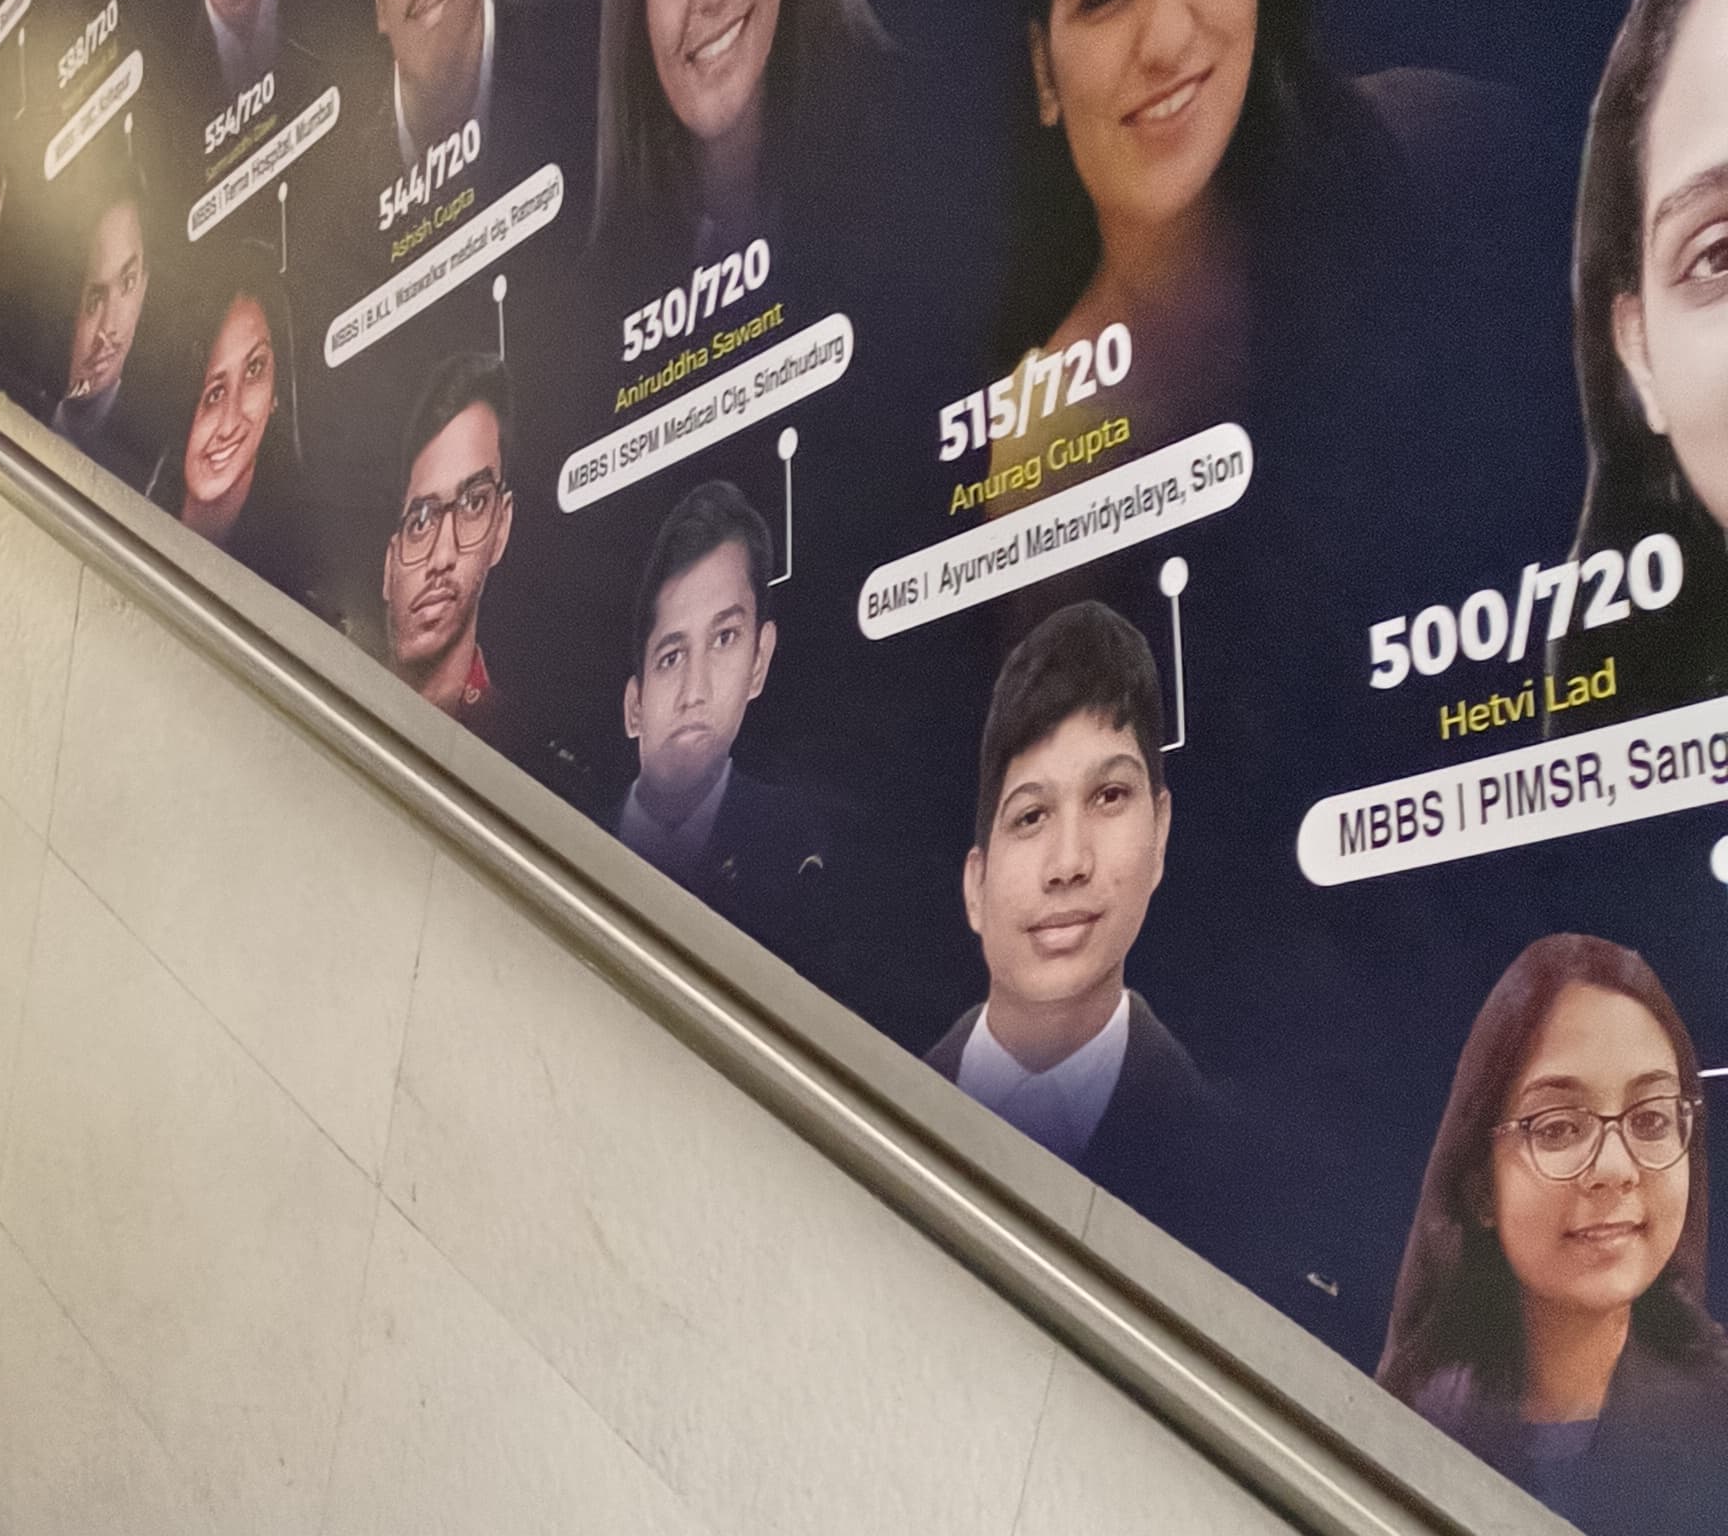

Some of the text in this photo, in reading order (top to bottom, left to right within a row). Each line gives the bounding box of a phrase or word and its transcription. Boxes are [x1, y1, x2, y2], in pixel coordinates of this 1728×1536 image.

[204, 70, 275, 155] 554/720
[377, 119, 481, 232] 544/720
[390, 187, 475, 263] Ashish Gupta
[623, 238, 770, 362] 530/720
[614, 302, 786, 414] Aniruddha Sawant
[938, 322, 1133, 463] 515/720
[567, 457, 609, 495] MBBS
[618, 431, 660, 469] SSPM
[662, 395, 719, 446] Medical
[753, 334, 846, 399] Sindhudurg
[948, 417, 1131, 516] Anurag Gupta
[867, 578, 920, 621] BAMS
[937, 534, 1020, 596] Ayurved
[1025, 475, 1188, 559] Mahavidyalaya,
[1189, 449, 1245, 493] Sion
[1368, 531, 1685, 690] 500/720
[1438, 656, 1618, 741] Hetvi Lad
[1338, 788, 1446, 858] MBBS
[1478, 751, 1618, 826] PIMSR,
